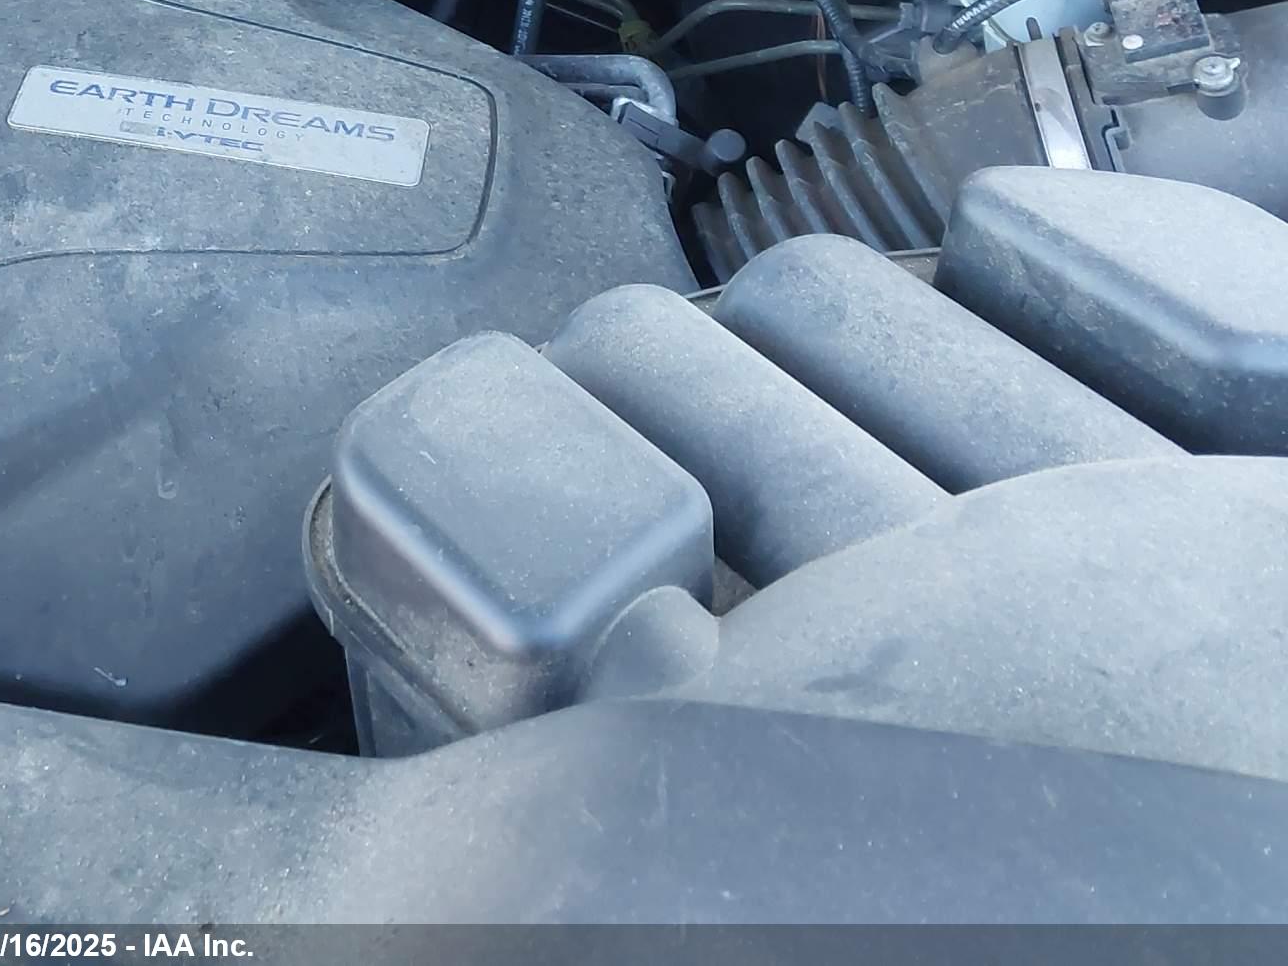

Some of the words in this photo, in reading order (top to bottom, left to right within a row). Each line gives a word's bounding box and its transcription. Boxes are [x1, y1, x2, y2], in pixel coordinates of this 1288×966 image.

[49, 79, 195, 112] EARTH
[206, 98, 396, 142] DREAMS
[124, 107, 304, 142] TECHNOLOGY
